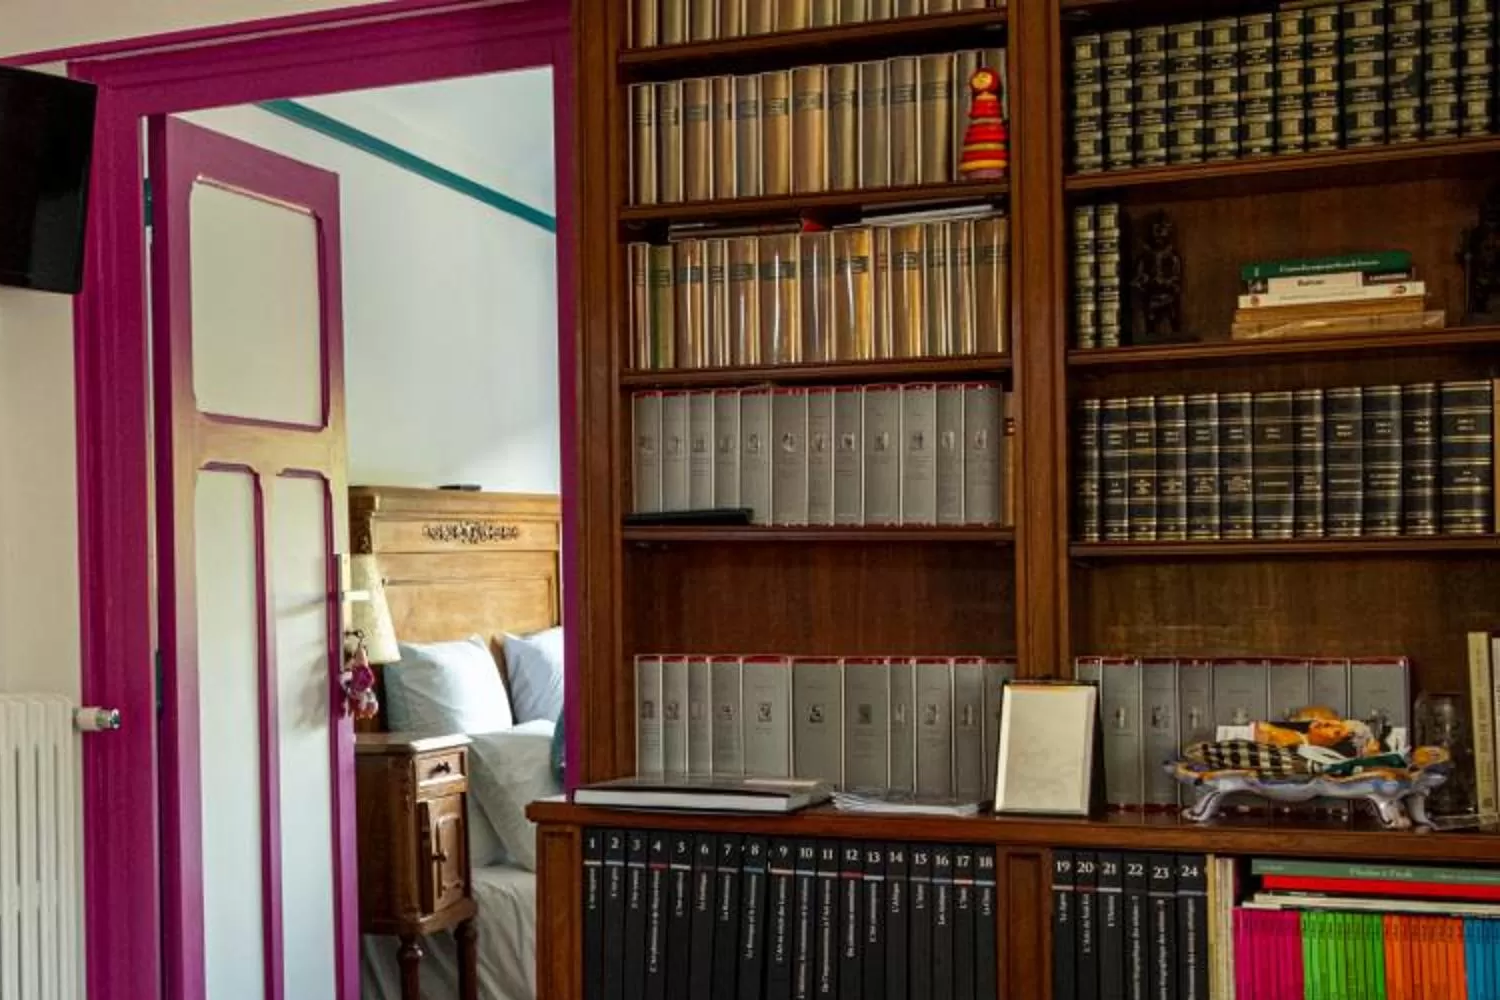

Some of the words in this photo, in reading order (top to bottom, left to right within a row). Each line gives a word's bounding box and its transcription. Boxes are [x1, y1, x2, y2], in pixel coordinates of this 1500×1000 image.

[589, 837, 596, 849] 1
[611, 837, 619, 849] 2
[633, 839, 641, 851] 3
[652, 840, 661, 851] 4
[677, 841, 685, 853] 5
[701, 844, 709, 854] 6
[723, 843, 732, 855] 7
[751, 845, 760, 856] 8
[780, 845, 789, 857] 9
[800, 847, 813, 859] 10
[822, 848, 833, 860] 11
[845, 849, 858, 861] 12
[867, 852, 880, 863] 13
[889, 852, 903, 863] 14
[914, 852, 928, 864] 15
[935, 854, 949, 866] 16
[956, 855, 970, 867] 17
[979, 856, 993, 868] 18
[1056, 860, 1071, 873] 19
[1077, 860, 1094, 873] 20
[1102, 862, 1117, 875] 21
[1127, 863, 1144, 876] 22
[1153, 866, 1169, 879] 23
[1181, 864, 1199, 877] 24
